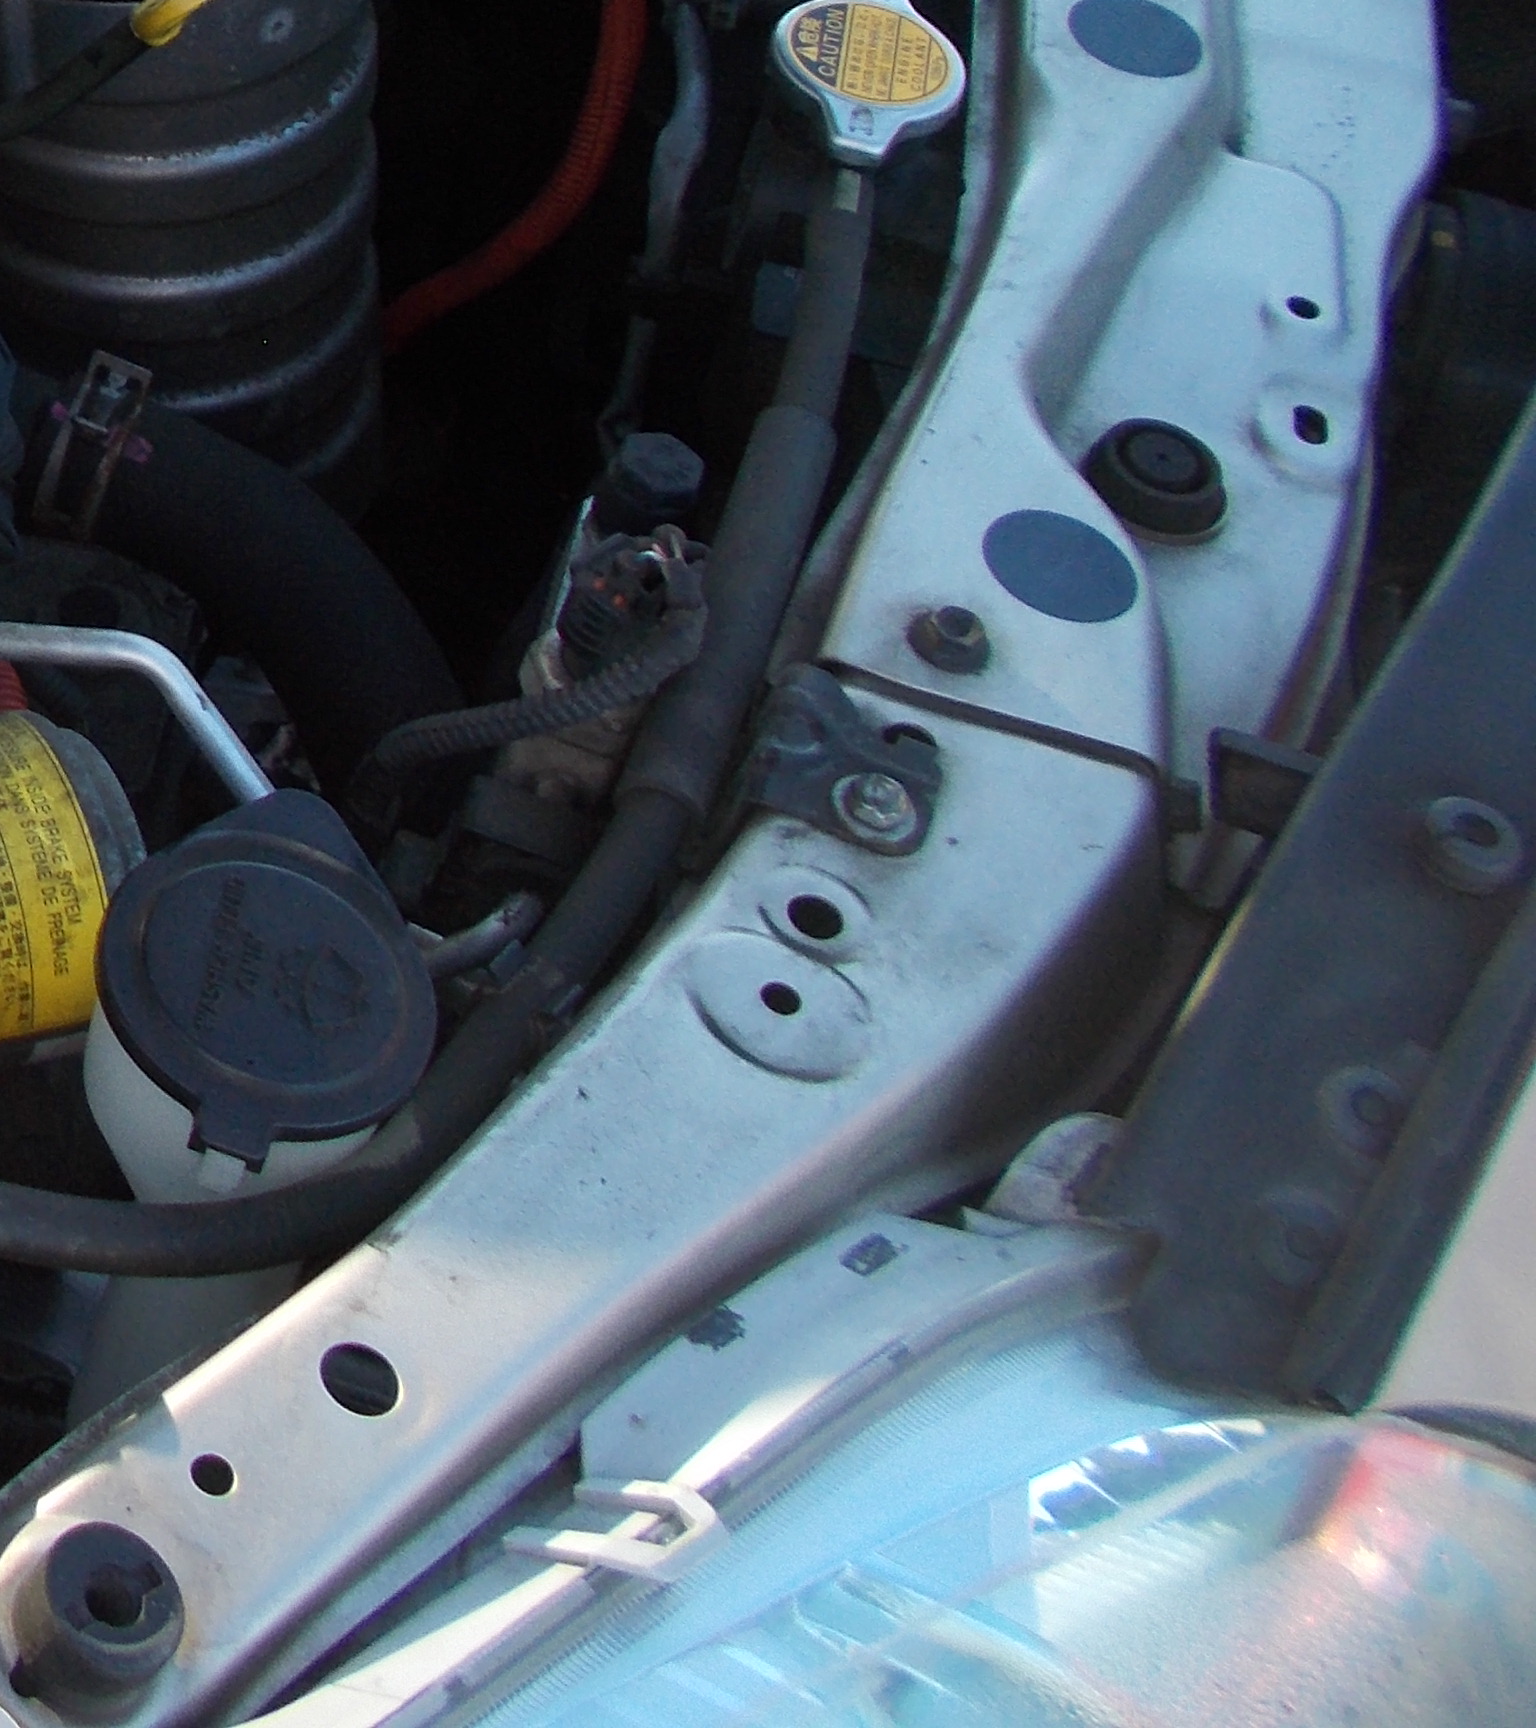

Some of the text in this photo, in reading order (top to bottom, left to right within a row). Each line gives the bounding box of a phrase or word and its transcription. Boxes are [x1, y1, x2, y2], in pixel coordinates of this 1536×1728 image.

[817, 7, 843, 78] CAUTION
[895, 37, 913, 84] ENGINE
[910, 36, 928, 92] COOLANT
[4, 781, 31, 815] DANS
[18, 818, 53, 882] SYSTEME
[21, 773, 51, 817] INSIDE
[38, 817, 69, 865] BRAKE
[55, 868, 84, 925] SYSTEM
[41, 884, 59, 908] DE
[45, 911, 69, 976] FREINAGE
